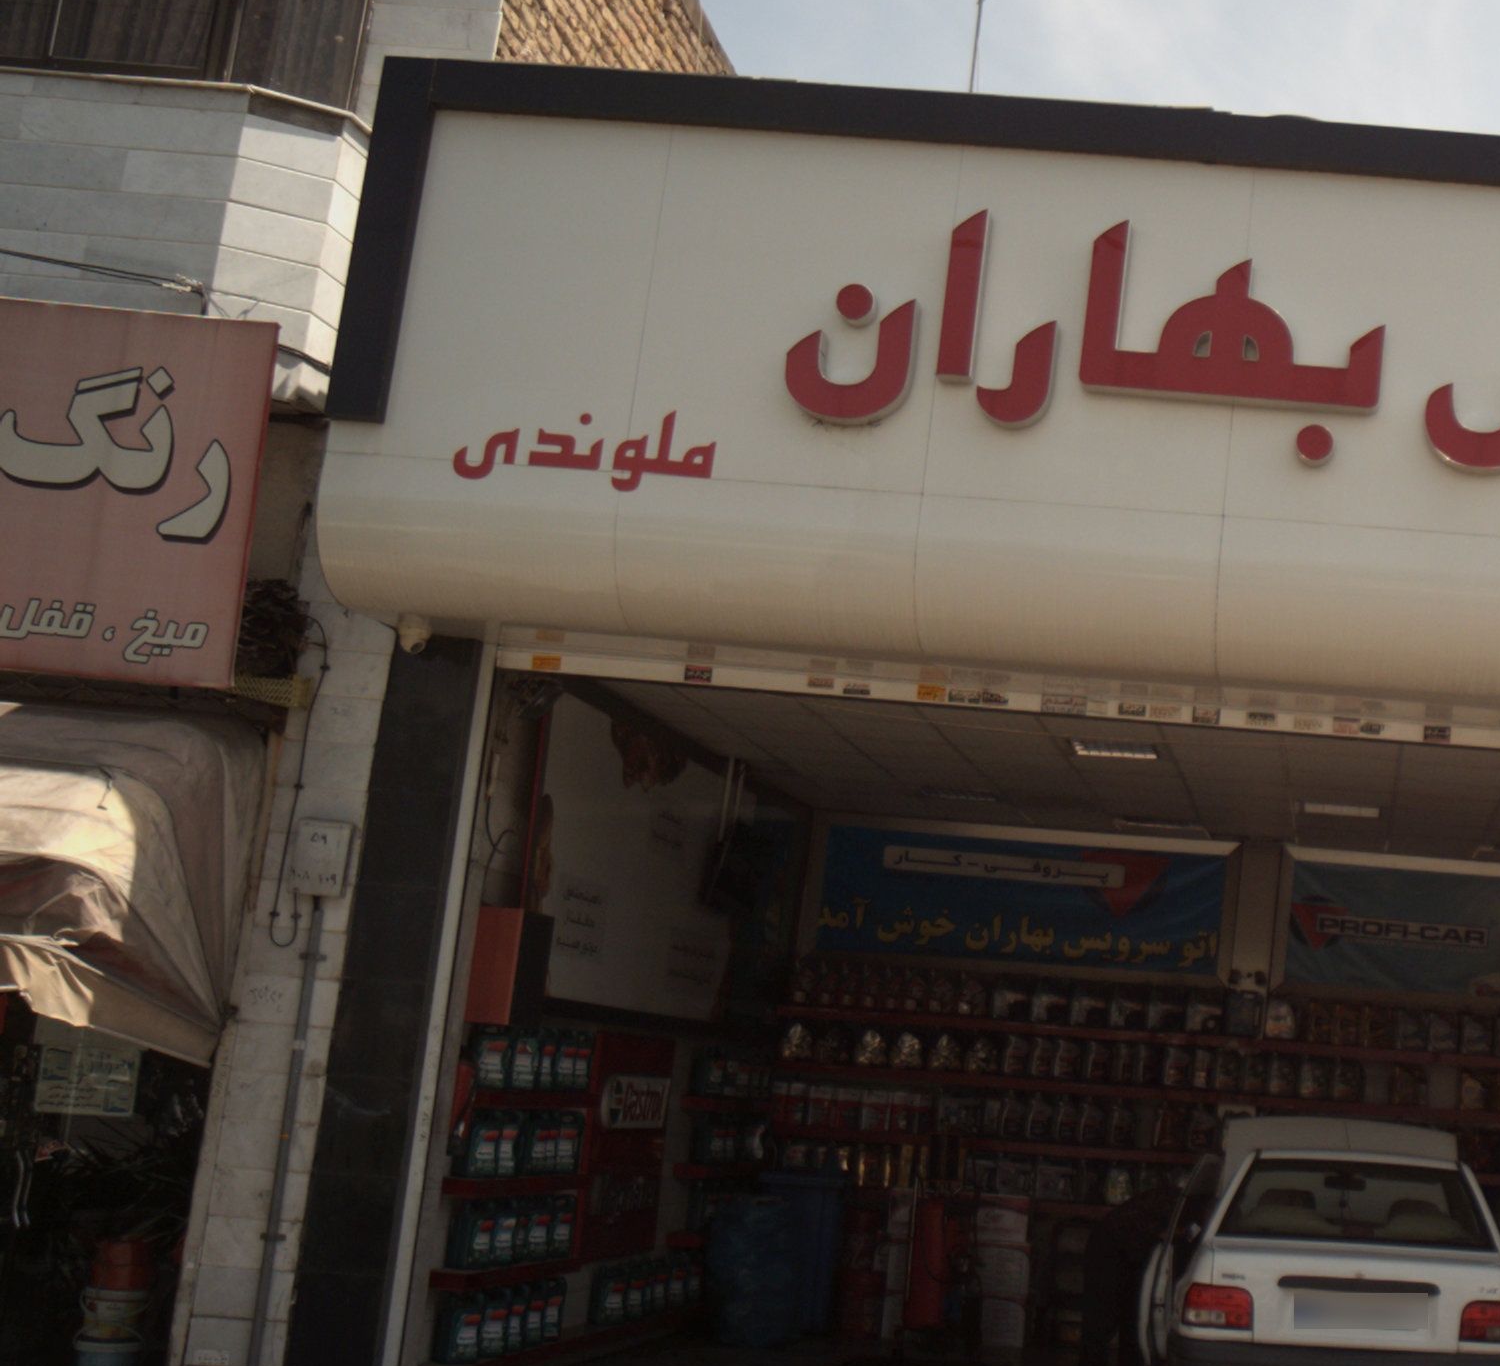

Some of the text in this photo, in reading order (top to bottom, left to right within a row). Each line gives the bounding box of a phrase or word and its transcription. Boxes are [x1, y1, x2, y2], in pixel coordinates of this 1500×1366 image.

[784, 207, 1386, 468] بهاران
[0, 366, 232, 545] رنگ
[0, 597, 96, 640] قفل
[123, 609, 209, 664] میخ
[876, 904, 957, 946] خوش
[964, 914, 1055, 955] بهاران
[1318, 916, 1487, 946] PROFI-CAR
[1063, 930, 1172, 963] سرویس
